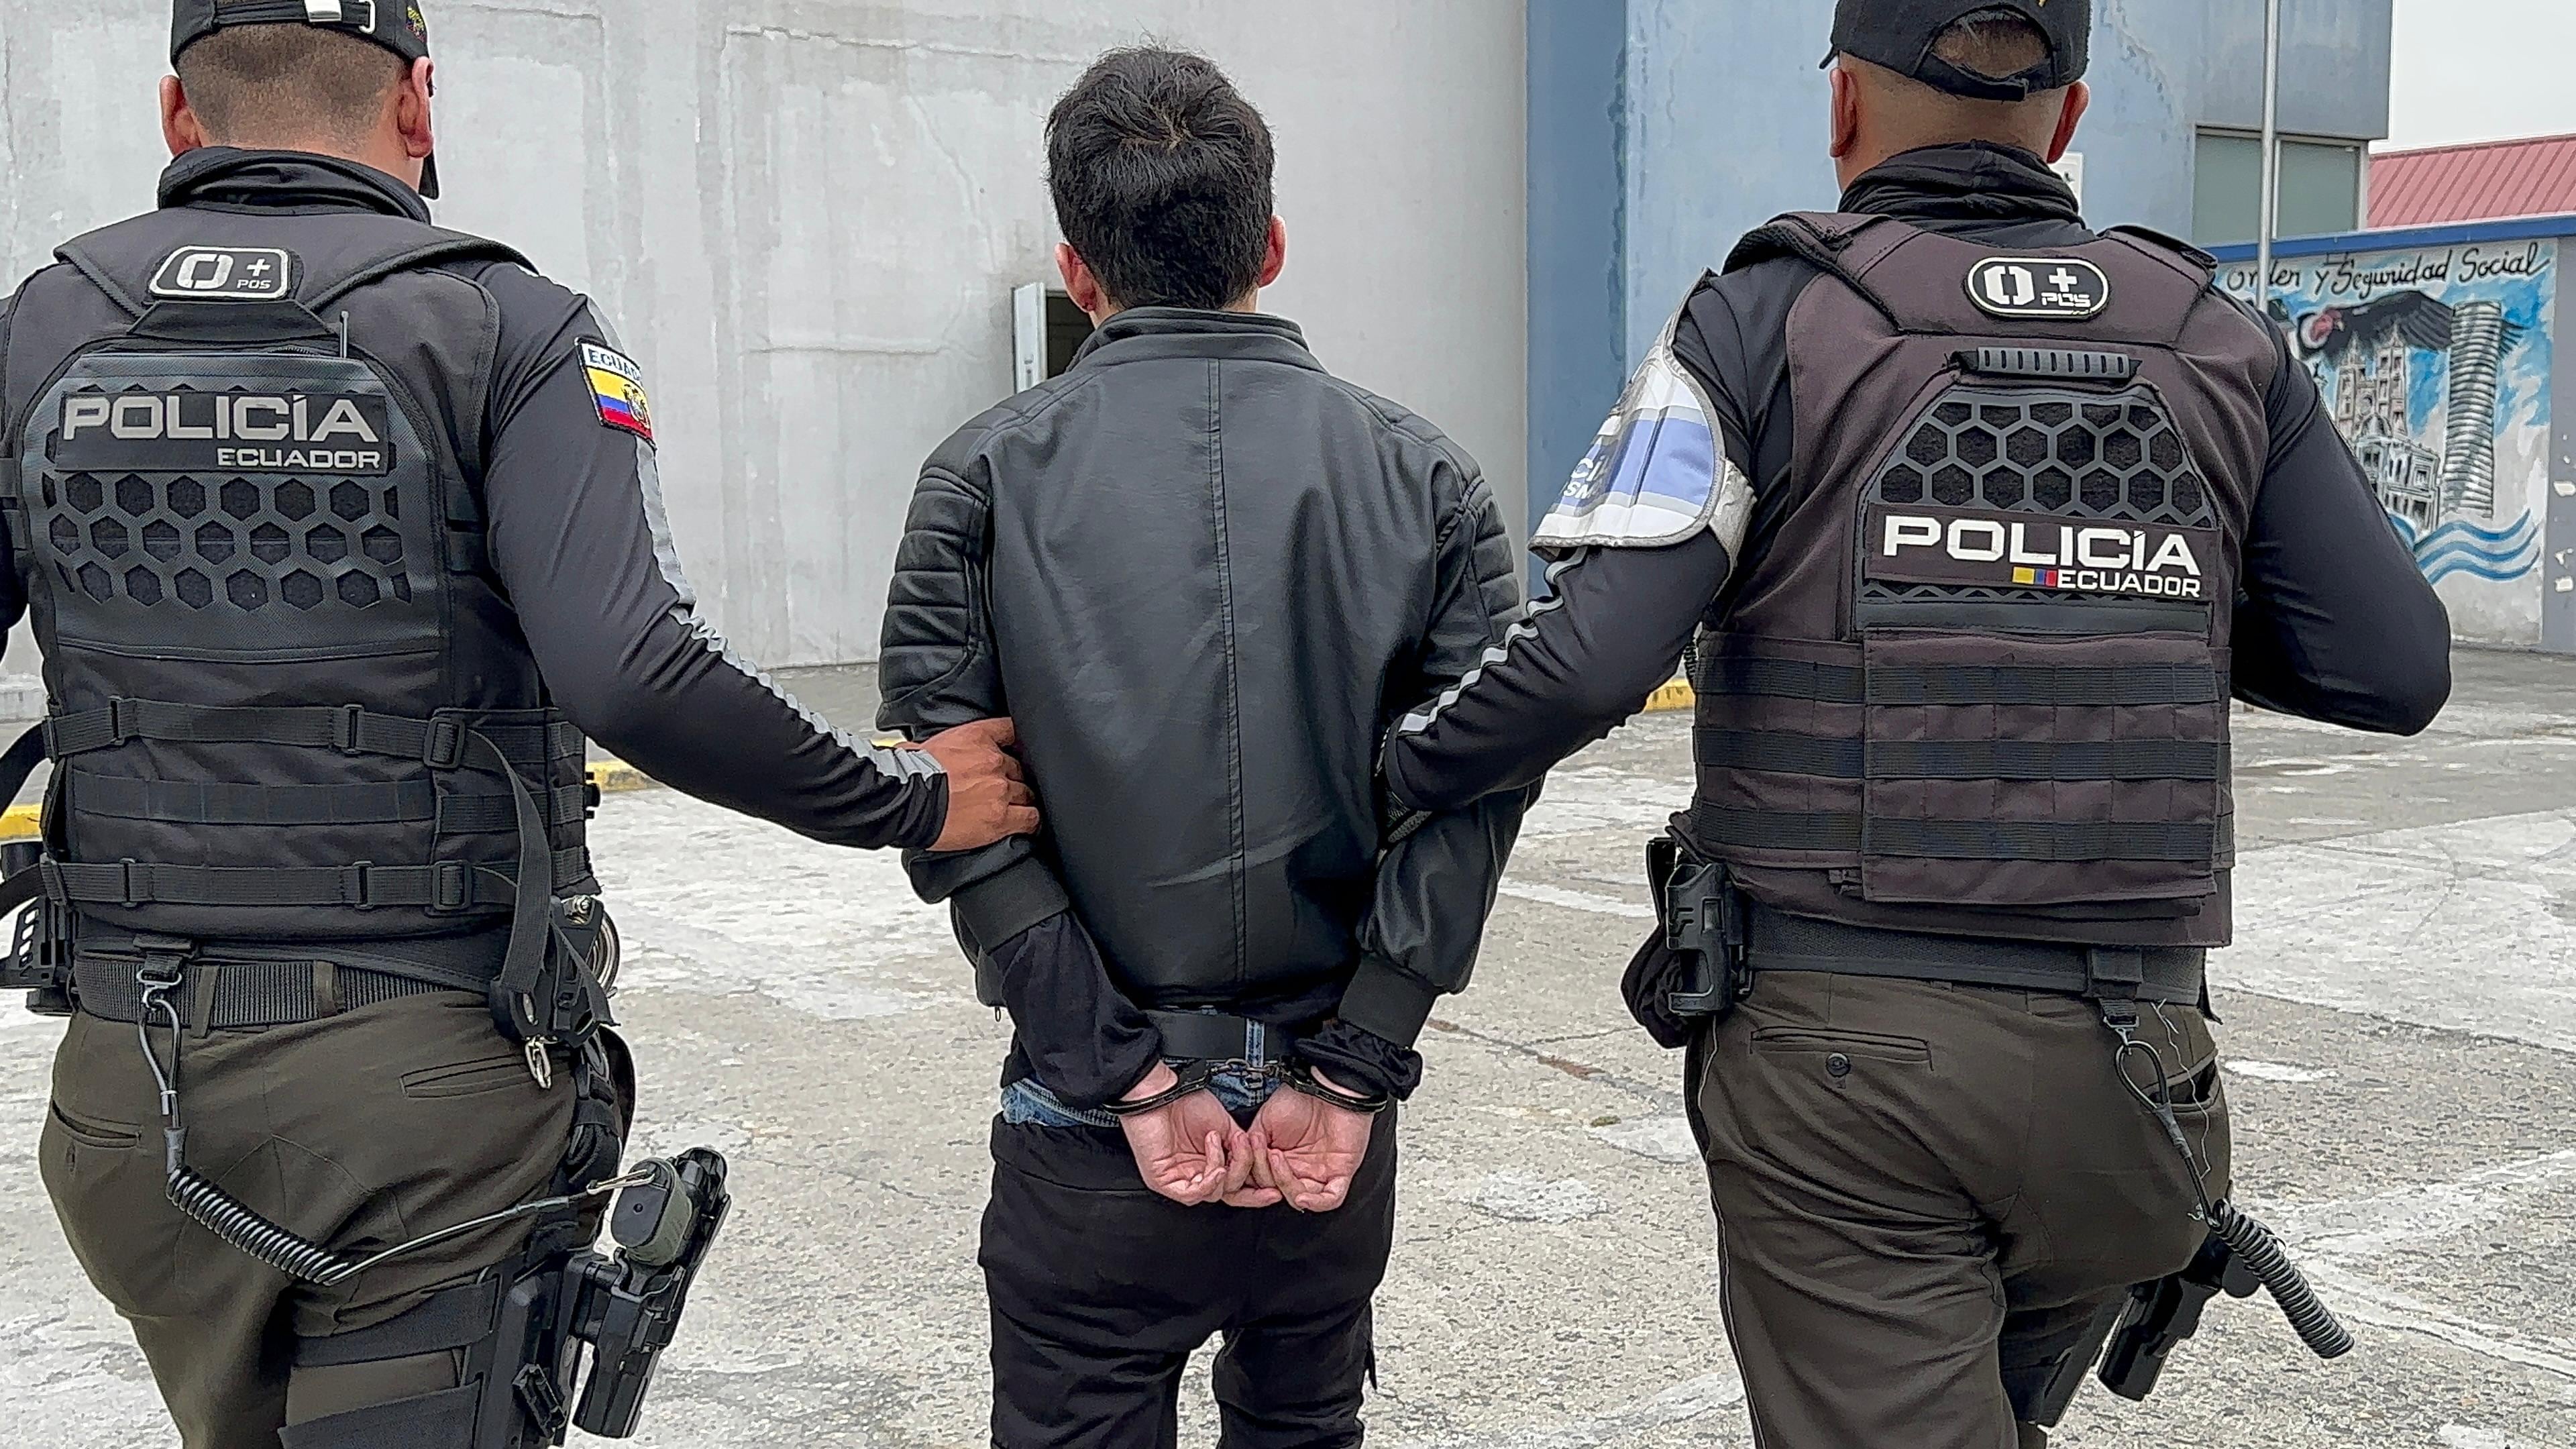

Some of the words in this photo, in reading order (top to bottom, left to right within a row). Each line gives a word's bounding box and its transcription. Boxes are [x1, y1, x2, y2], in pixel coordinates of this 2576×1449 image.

[236, 279, 272, 290] POS
[2330, 250, 2453, 300] Seguridad
[2458, 241, 2551, 283] Social
[2041, 292, 2092, 308] POS
[62, 394, 379, 443] POLICÍA
[217, 447, 380, 469] ECUADOR
[1882, 515, 2202, 577] POLICÍA
[2057, 569, 2201, 598] ECUADOR
